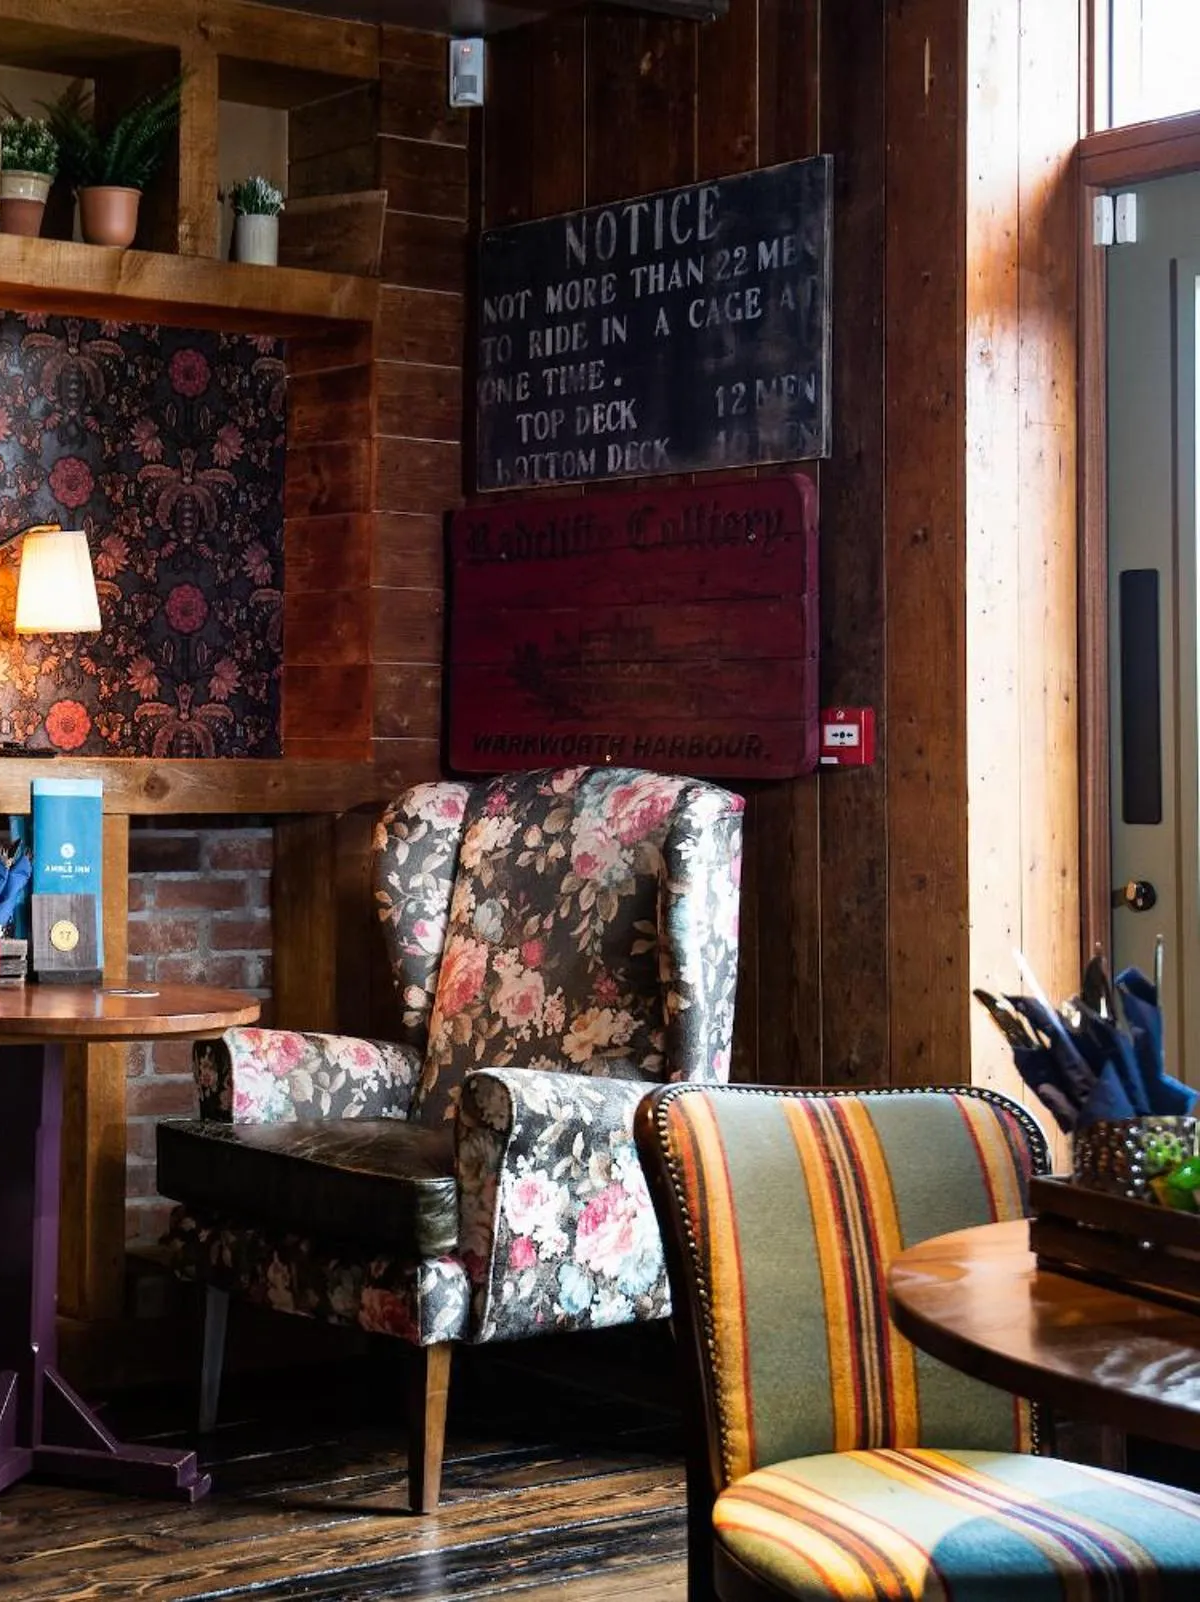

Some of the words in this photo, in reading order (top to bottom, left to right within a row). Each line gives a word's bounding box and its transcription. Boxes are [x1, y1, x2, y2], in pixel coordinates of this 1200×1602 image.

[564, 184, 721, 270] NOTICE
[482, 287, 532, 326] NOT
[545, 271, 617, 316] MORE
[629, 252, 705, 299] THAN
[716, 244, 750, 281] 22
[481, 335, 513, 367] TO
[528, 321, 588, 361] RIDE
[601, 314, 628, 346] IN
[654, 305, 671, 338] A
[688, 286, 762, 330] CAGE
[478, 371, 530, 406] ONE
[516, 408, 565, 445] TOP
[575, 397, 638, 437] DECK
[714, 380, 748, 418] 12
[607, 436, 672, 473] DECK
[472, 731, 628, 757] WARKWORTH
[632, 732, 772, 761] HARBOUR.
